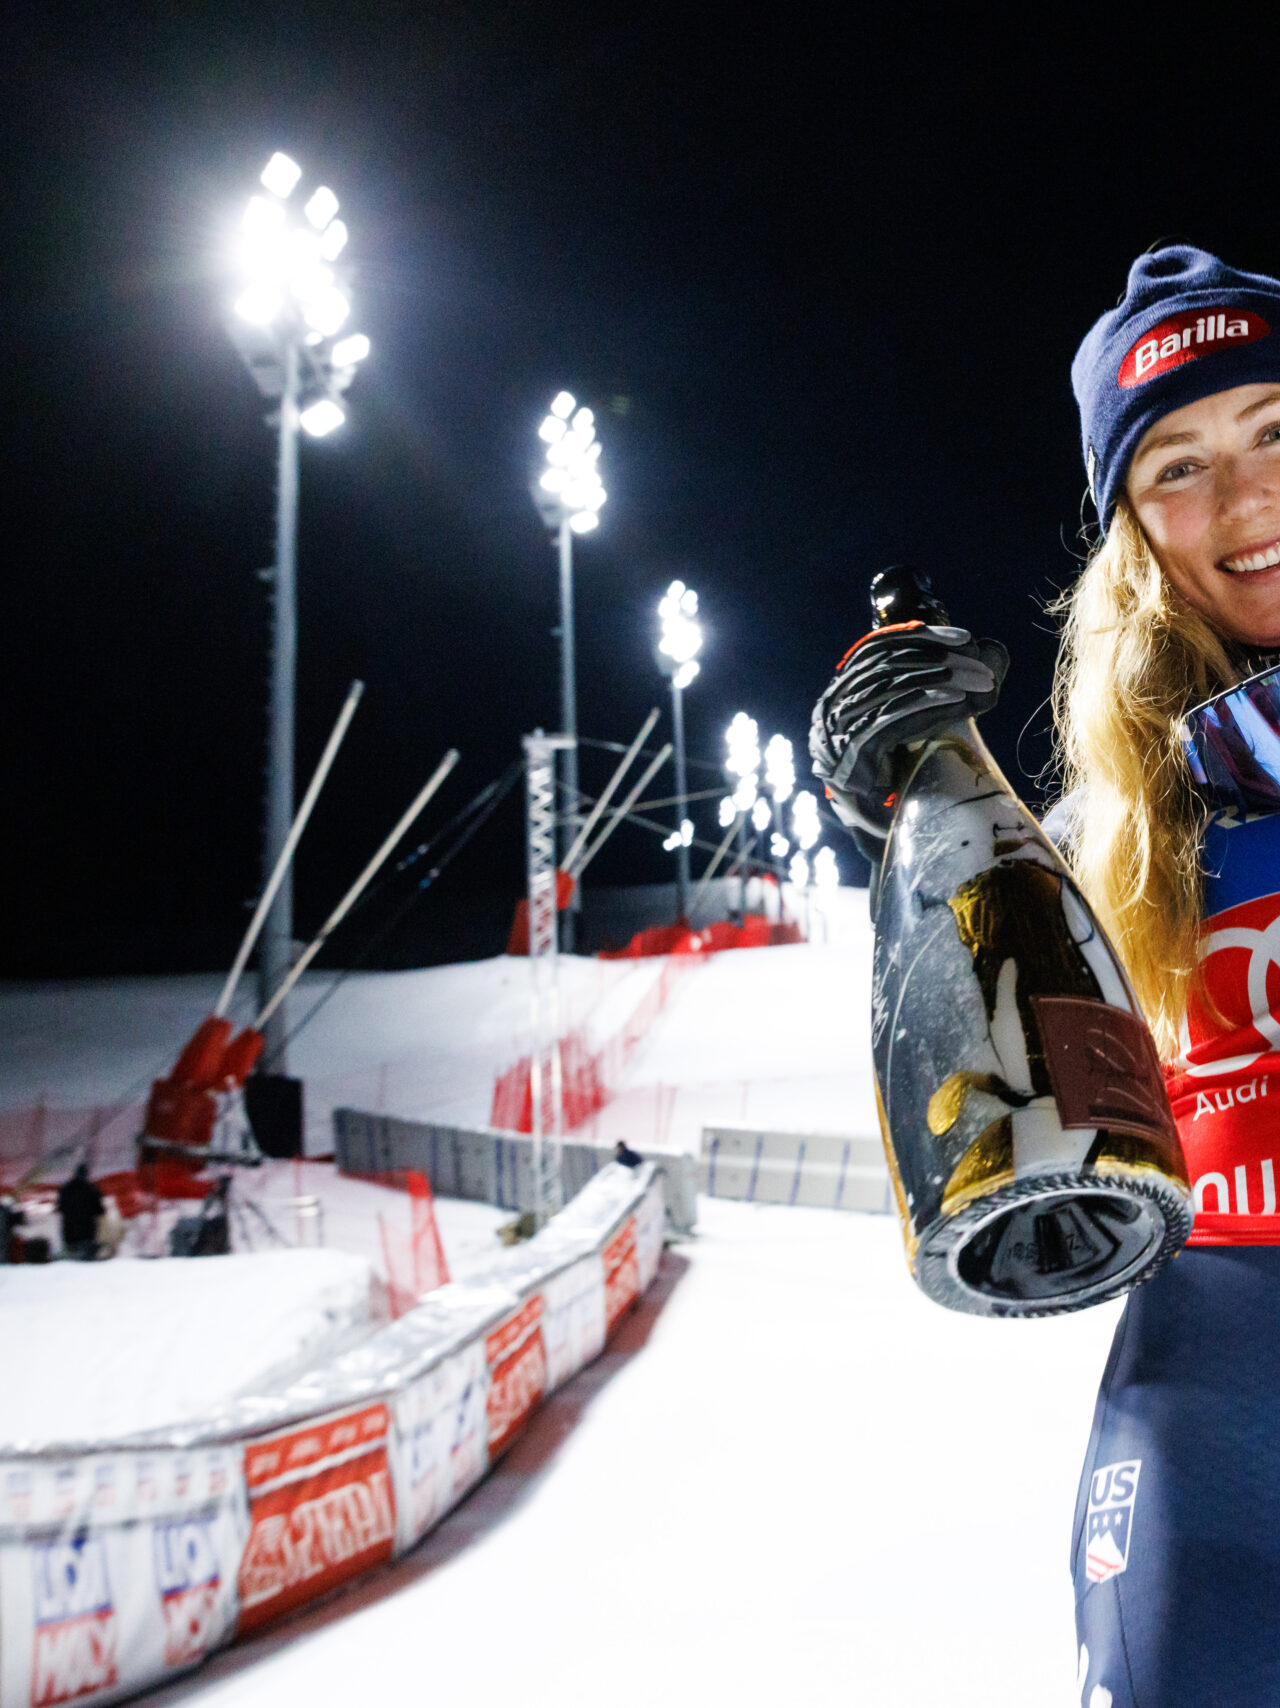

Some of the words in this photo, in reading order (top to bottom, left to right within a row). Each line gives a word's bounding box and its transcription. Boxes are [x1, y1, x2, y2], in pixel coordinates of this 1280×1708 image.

[1135, 314, 1249, 378] Barilla
[1192, 1075, 1268, 1121] Audi
[1091, 1467, 1136, 1506] US
